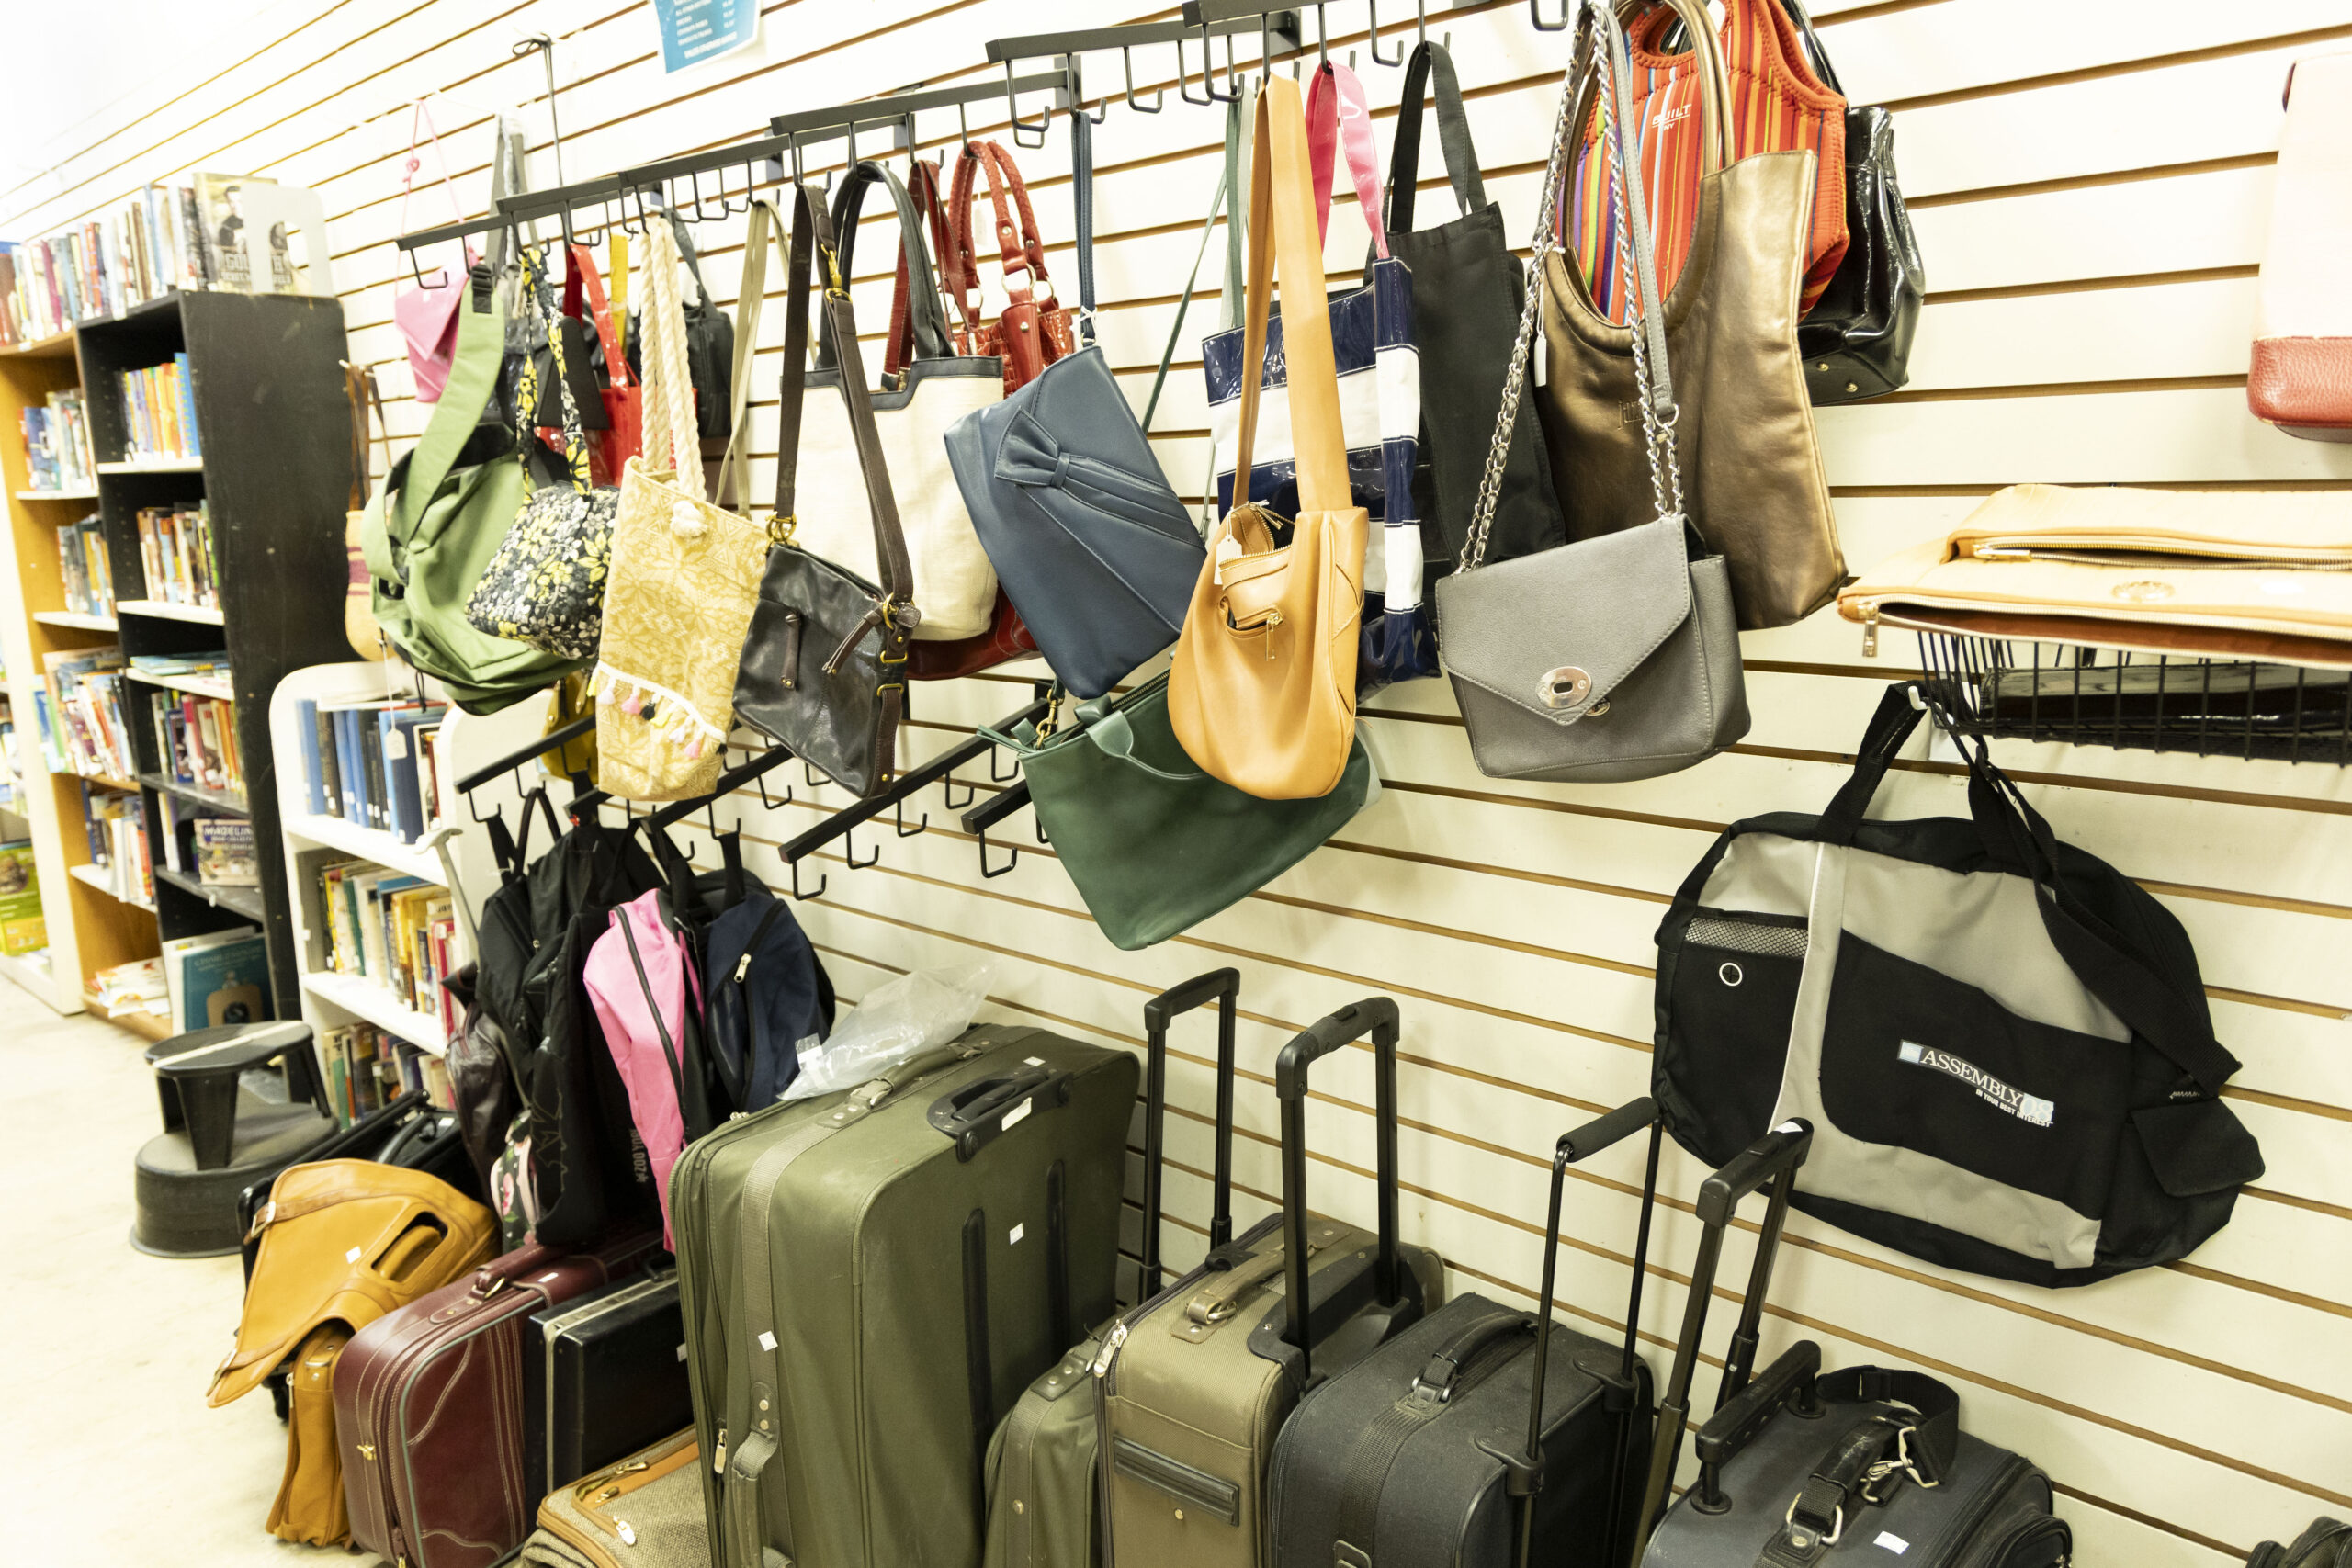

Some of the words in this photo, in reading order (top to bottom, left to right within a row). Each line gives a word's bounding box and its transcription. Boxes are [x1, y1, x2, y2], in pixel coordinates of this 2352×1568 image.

[1652, 103, 1692, 126] BUILT
[1919, 1050, 2023, 1107] ASSEMBLY
[1984, 1091, 1999, 1107] YOUR
[1999, 1101, 2017, 1116] BEST
[2016, 1110, 2054, 1128] INTEREST
[632, 1153, 647, 1173] ZOO
